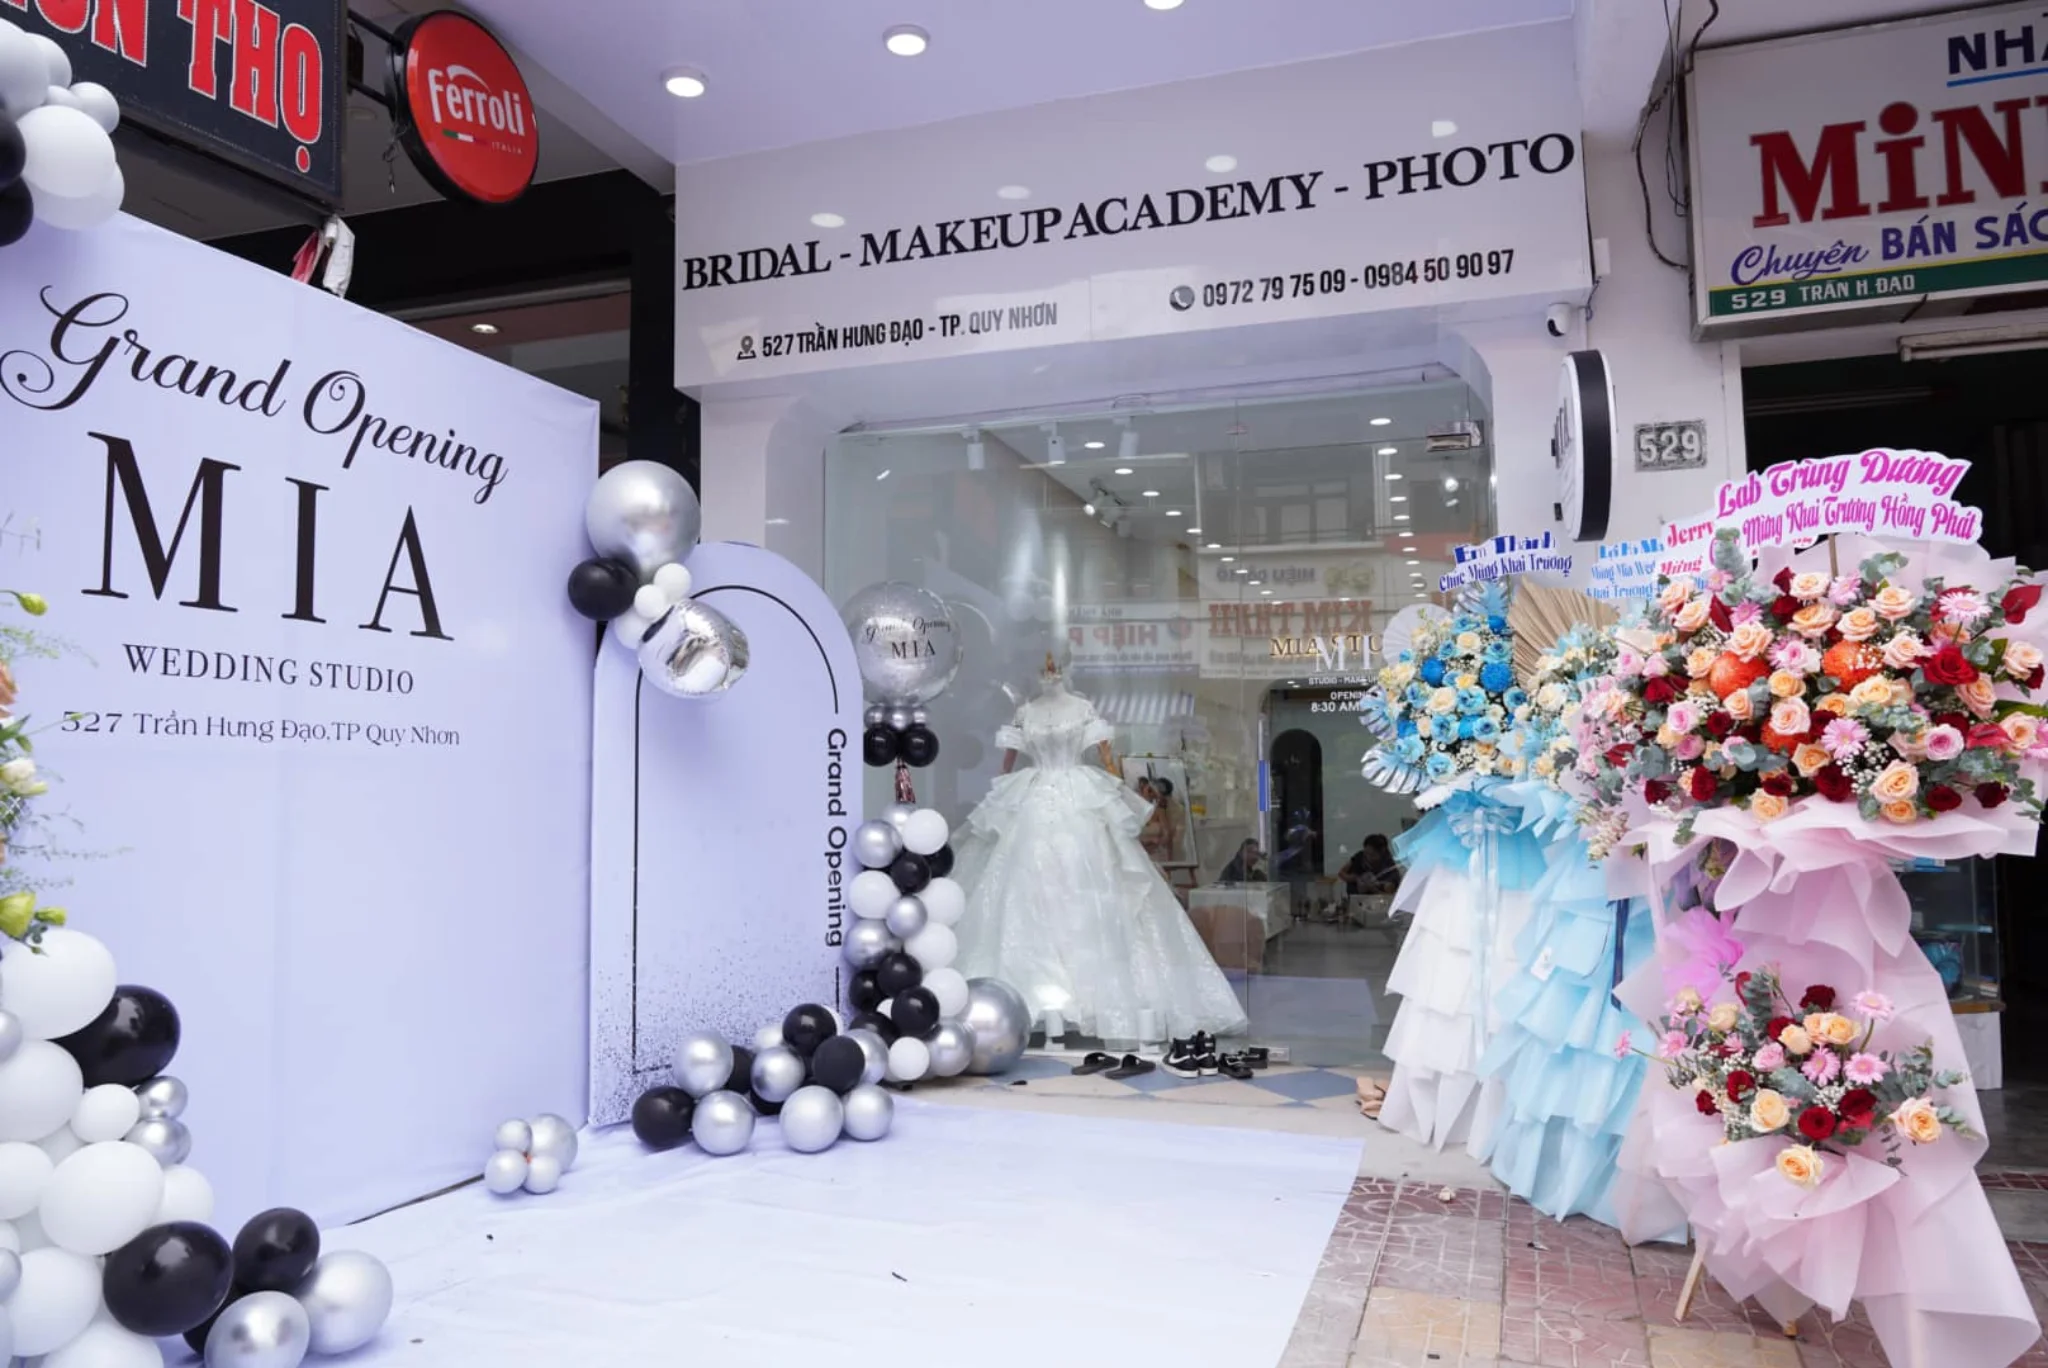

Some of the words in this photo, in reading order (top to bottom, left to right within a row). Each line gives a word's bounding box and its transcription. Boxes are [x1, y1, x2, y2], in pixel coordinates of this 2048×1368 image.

[1948, 12, 2048, 75] NH
[177, 0, 323, 173] THỌ
[428, 68, 525, 137] Ferroli
[491, 141, 523, 155] ITALIA
[1750, 95, 2048, 228] MiN
[683, 240, 832, 290] BRIDAL
[860, 207, 1063, 267] MAKEUP
[1063, 171, 1324, 240] ACADEMY
[1364, 133, 1575, 200] PHOTO
[1202, 279, 1254, 308] 0972
[1260, 276, 1284, 301] 79
[1289, 272, 1314, 298] 75
[1320, 269, 1346, 294] 09
[1364, 261, 1419, 289] 0984
[1423, 256, 1450, 283] 50
[1456, 252, 1484, 279] 90
[1487, 249, 1514, 275] 97
[1731, 239, 1869, 286] Chuyên
[1881, 215, 1957, 261] BÁN
[1731, 288, 1787, 310] 529
[1874, 273, 1916, 296] ĐẠO
[762, 334, 795, 357] 527
[796, 321, 838, 354] TRẦN
[843, 324, 886, 348] HƯNG
[889, 317, 923, 346] ĐẠO
[969, 309, 1003, 335] QUY
[1008, 301, 1057, 331] NHƠN
[0, 285, 292, 417] Grand
[303, 370, 509, 504] Opening
[1638, 428, 1701, 463] 529
[1717, 473, 1762, 519] Lab
[1766, 459, 1850, 497] Trùng
[1860, 450, 1966, 496] Dương
[81, 431, 455, 641] MIA
[1786, 498, 1820, 534] Khai
[1823, 496, 1877, 532] Trương
[1881, 492, 1926, 538] Hồng
[1931, 502, 1976, 540] Phát
[1501, 554, 1527, 575] Khai
[123, 643, 298, 685] WEDDING
[310, 661, 414, 694] STUDIO
[891, 639, 936, 659] MIA
[60, 711, 123, 733] 527
[133, 709, 198, 736] Trần
[206, 717, 275, 743] Hưng
[365, 722, 407, 748] Quy
[411, 725, 461, 747] Nhơn
[1311, 701, 1336, 713] 8:30
[826, 727, 848, 817] Grand
[824, 826, 848, 948] Opening
